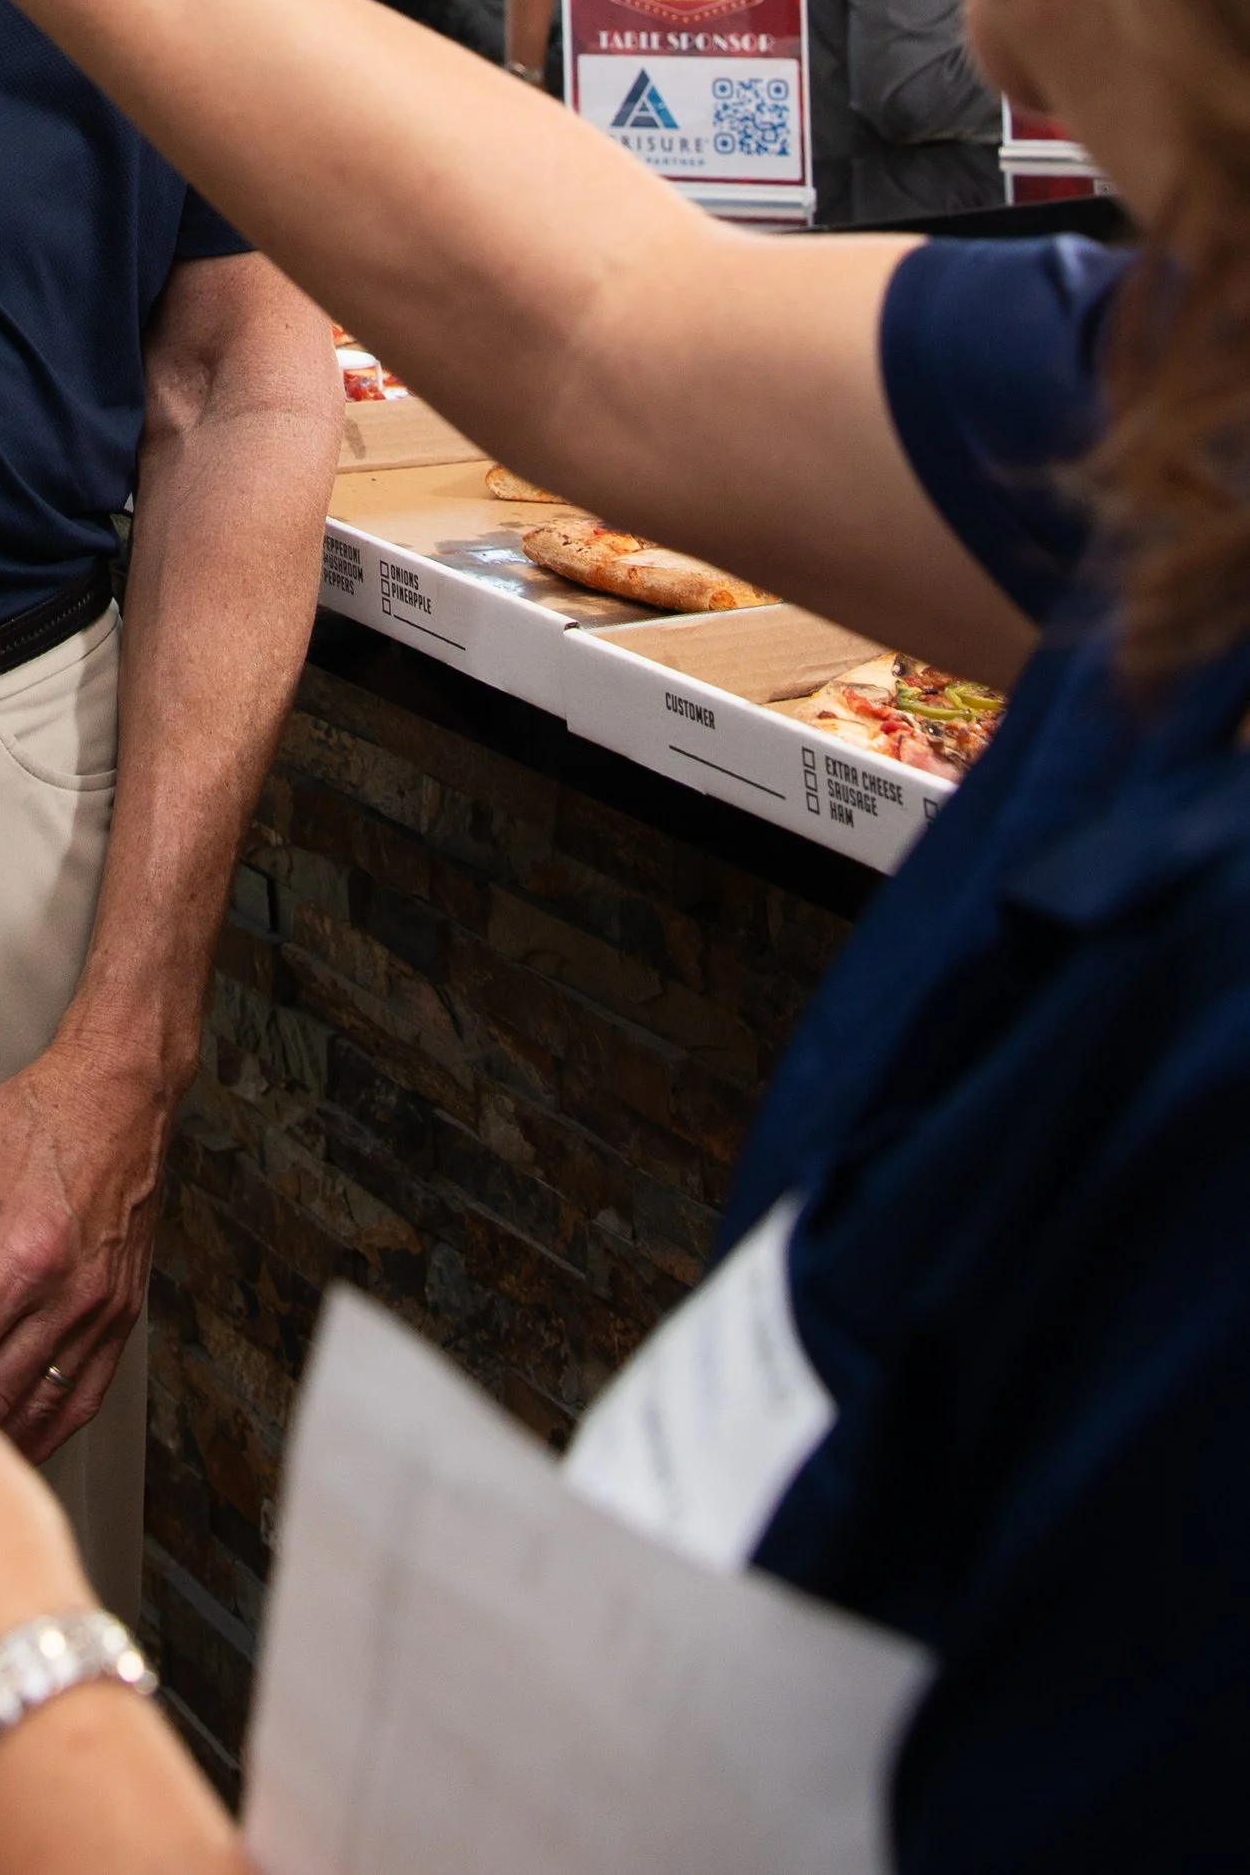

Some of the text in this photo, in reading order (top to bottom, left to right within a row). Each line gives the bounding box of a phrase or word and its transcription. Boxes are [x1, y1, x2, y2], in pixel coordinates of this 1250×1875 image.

[599, 30, 775, 53] TABLE SPONSOR
[612, 135, 704, 153] RISURE
[323, 552, 364, 583] MUSHROOM
[324, 568, 354, 595] PEPPERS
[390, 564, 419, 590] ONIONS
[392, 583, 432, 615] PINEAPPLE
[665, 692, 716, 730] CUSTOMER
[825, 756, 903, 805] EXTRA CHEESE
[827, 778, 878, 816] SAUSAGE
[829, 800, 854, 828] HAM
